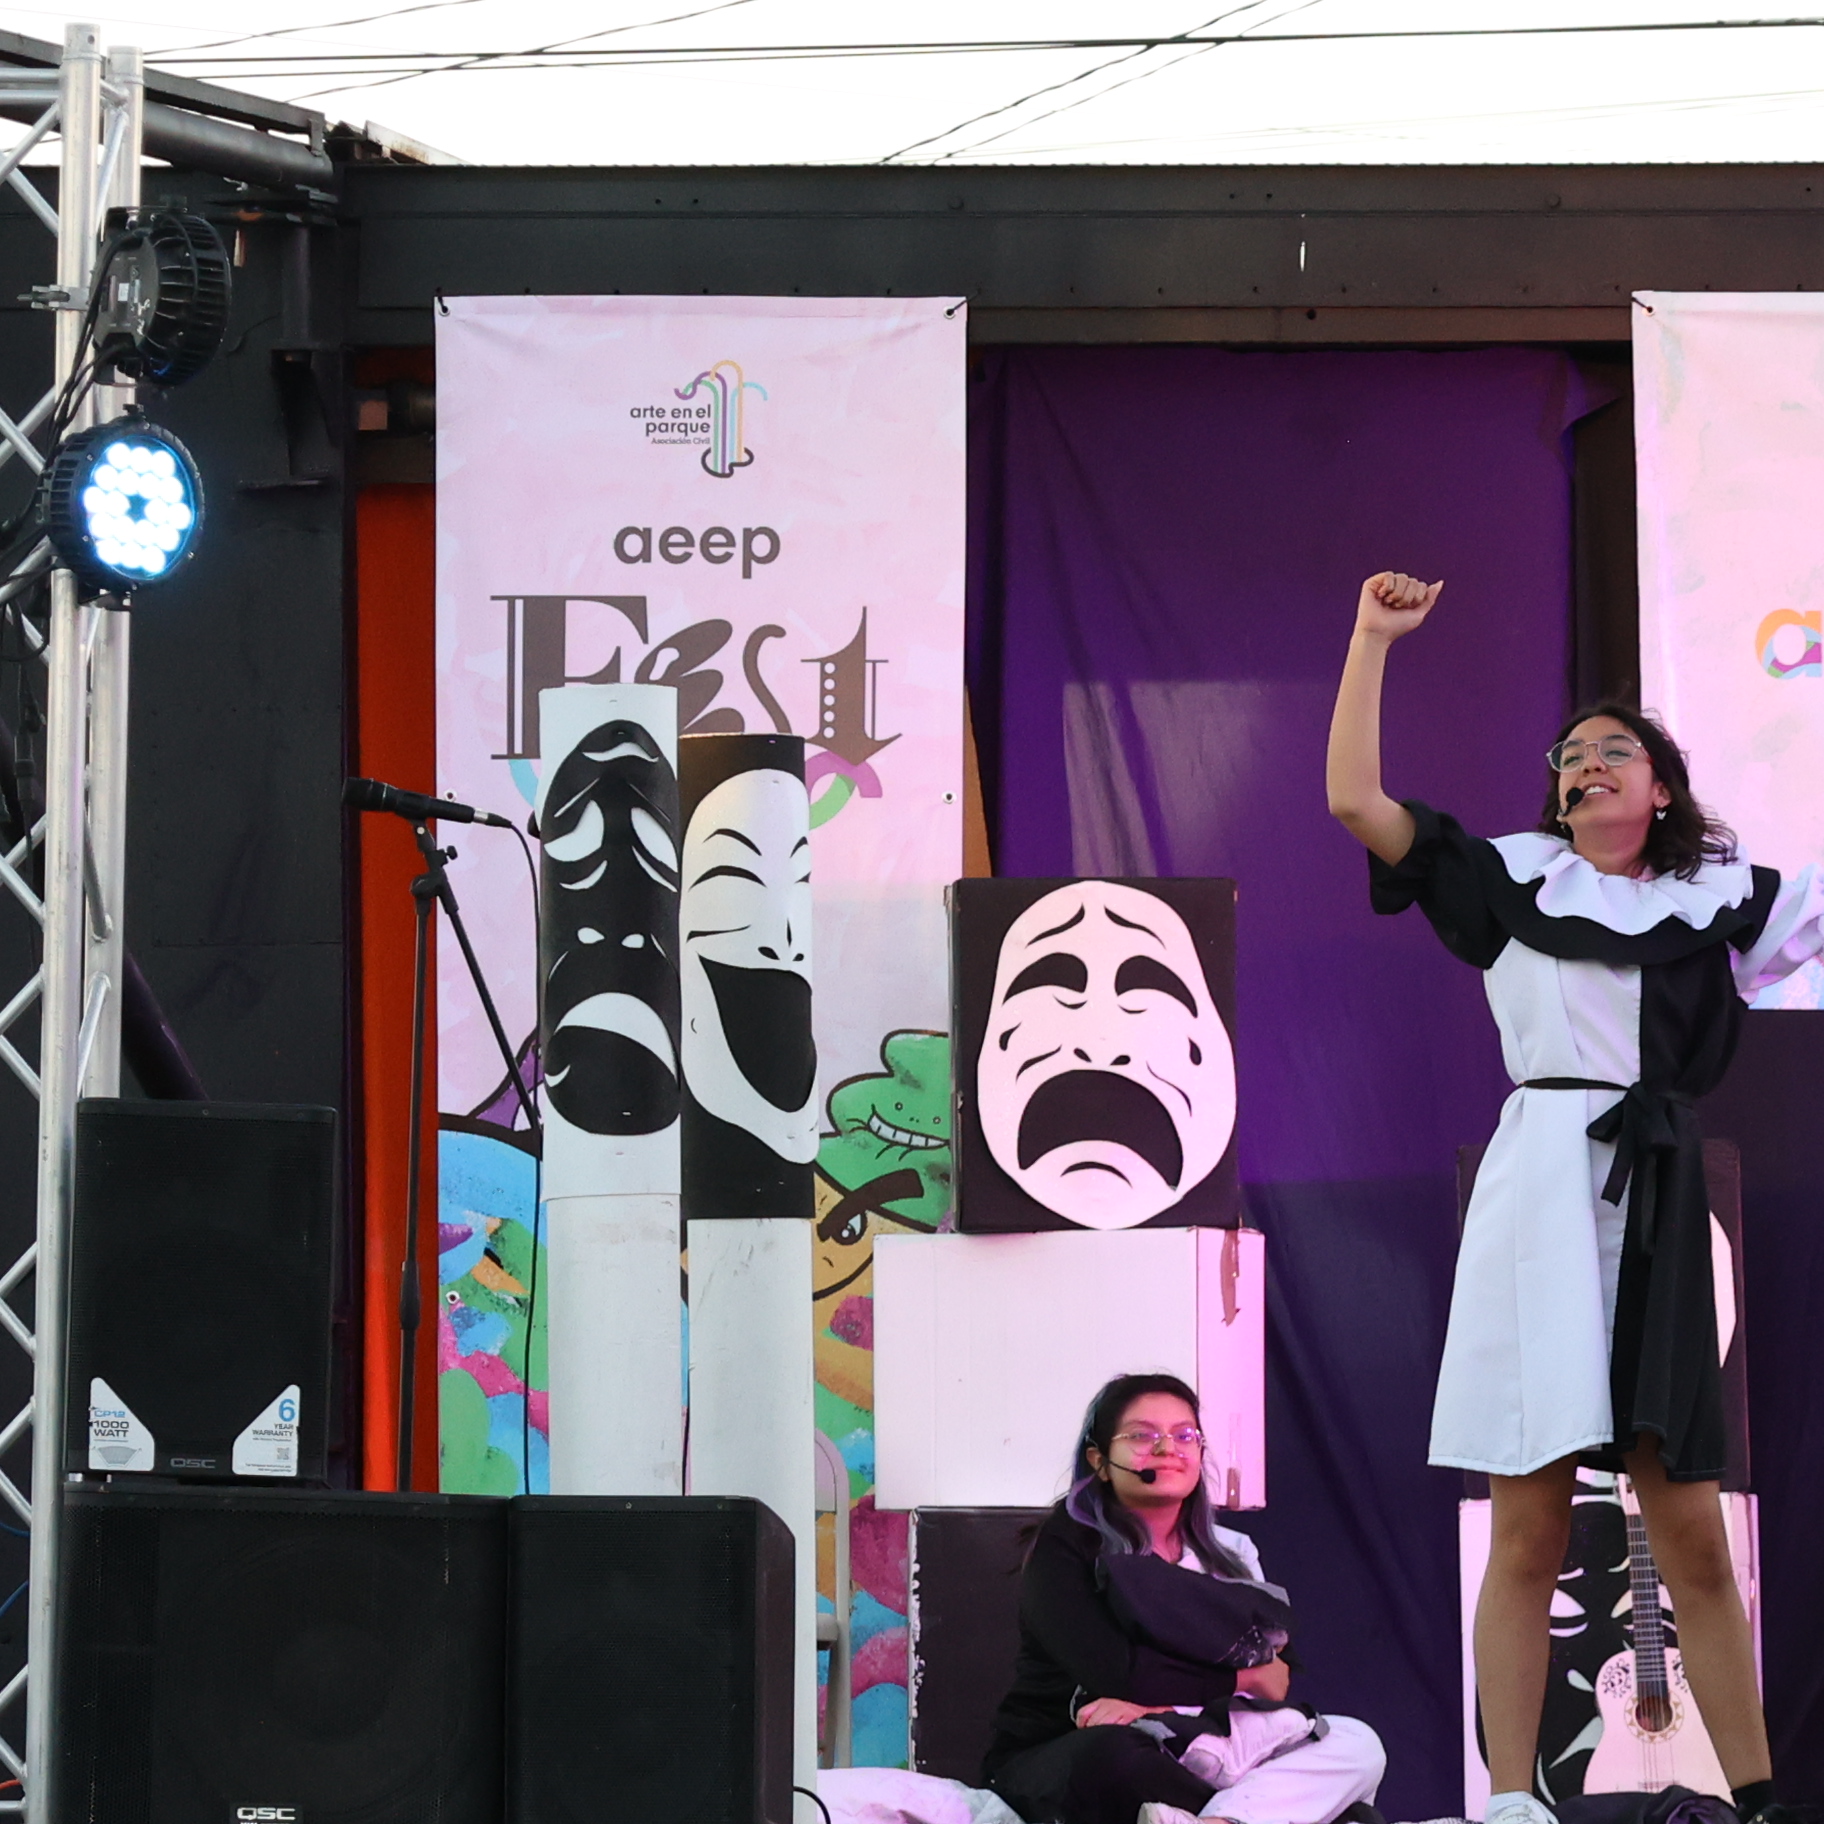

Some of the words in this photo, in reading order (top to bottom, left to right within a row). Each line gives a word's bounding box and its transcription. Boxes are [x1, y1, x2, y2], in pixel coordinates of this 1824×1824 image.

[630, 405, 666, 419] arte
[671, 407, 692, 419] en
[695, 404, 711, 419] el
[645, 422, 711, 437] parque
[613, 526, 781, 579] aeep
[94, 1410, 126, 1419] CP12
[278, 1398, 296, 1422] 6
[93, 1420, 130, 1429] 1000
[94, 1429, 129, 1437] WATT
[252, 1429, 294, 1437] WARRANTY
[170, 1457, 216, 1469] QSC
[237, 1807, 296, 1820] QSC
